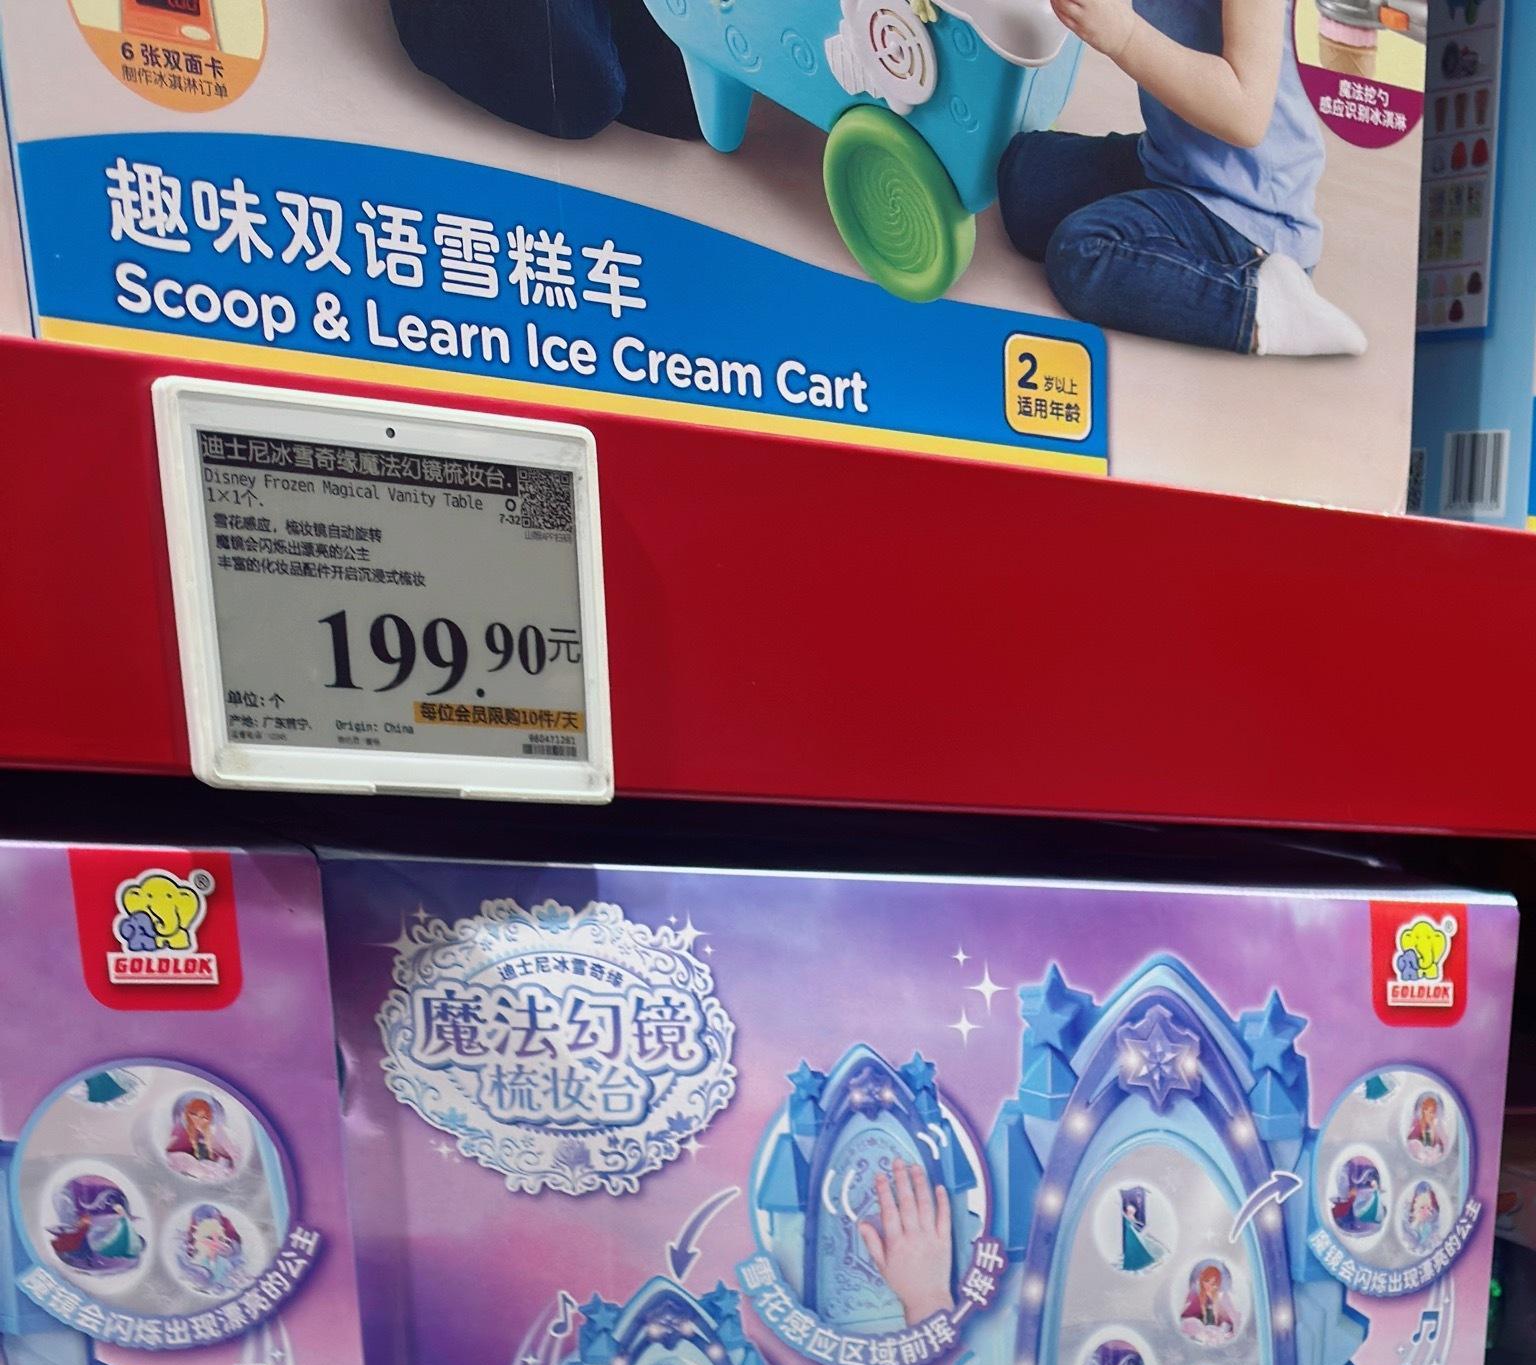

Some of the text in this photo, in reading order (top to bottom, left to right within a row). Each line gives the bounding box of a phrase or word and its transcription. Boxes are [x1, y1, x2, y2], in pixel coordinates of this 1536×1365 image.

[121, 42, 223, 79] 6 张双面卡
[105, 156, 648, 319] 趣味双语雪糕车
[116, 262, 869, 414] Scoop & Learn Ice Cream Cart
[1018, 352, 1078, 395] 2 岁以上
[1017, 395, 1081, 423] 适用年龄
[204, 467, 484, 511] Disney Frozen Magical Vanity Table
[420, 702, 579, 729] 每位会员限购10件/天
[114, 957, 213, 974] GOLDLOK
[496, 956, 624, 988] 迪士尼冰雪奇缘
[1391, 985, 1450, 999] GOLDLOK
[421, 988, 695, 1062] 魔法幻镜
[489, 1062, 640, 1114] 梳妆台
